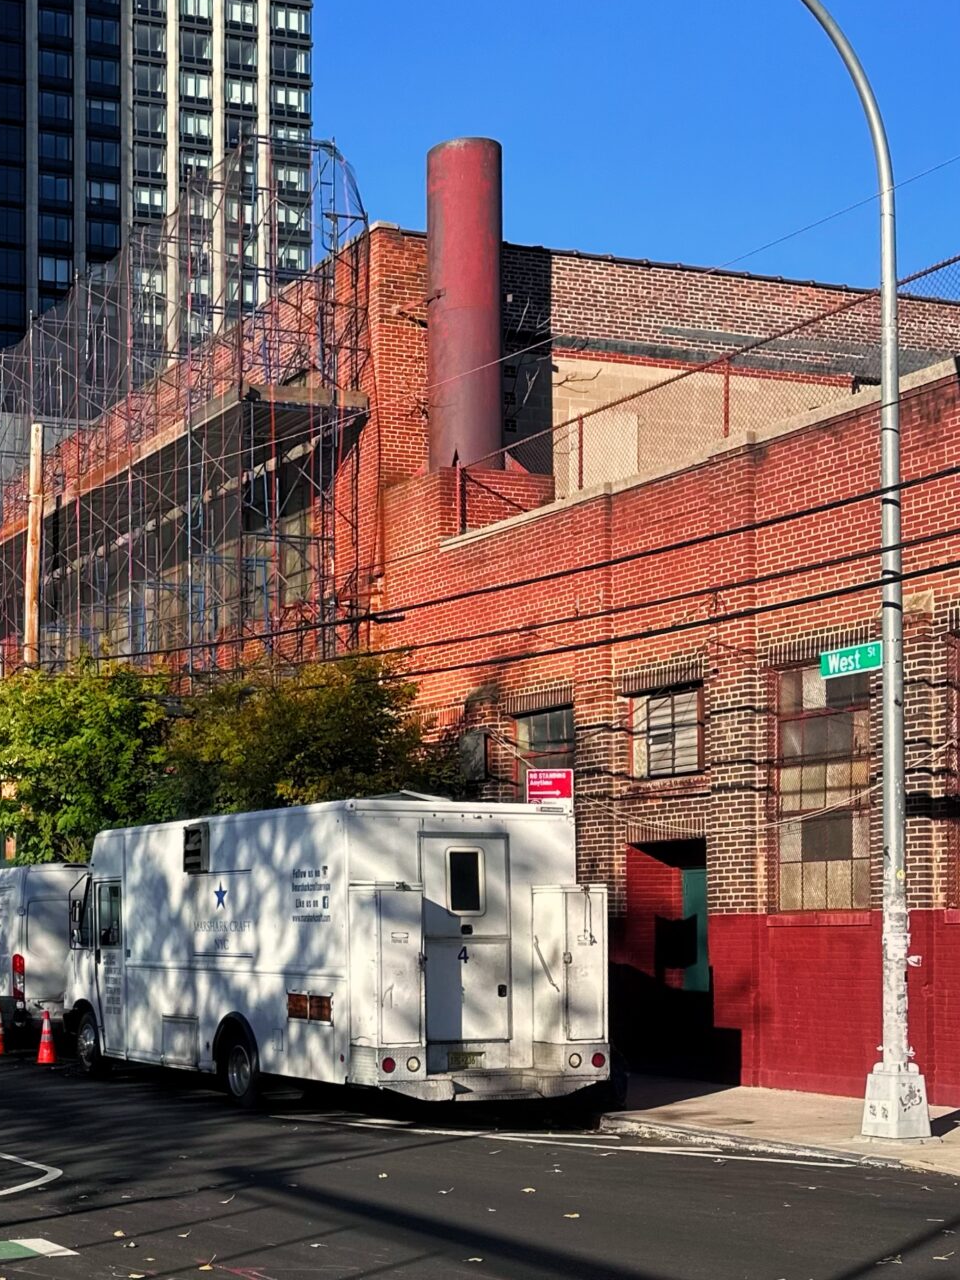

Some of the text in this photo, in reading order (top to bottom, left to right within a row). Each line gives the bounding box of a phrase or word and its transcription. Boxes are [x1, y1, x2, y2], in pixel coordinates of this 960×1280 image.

[827, 646, 876, 674] West St
[229, 921, 250, 932] CRAFT
[214, 938, 229, 950] NYC
[458, 946, 469, 963] 4
